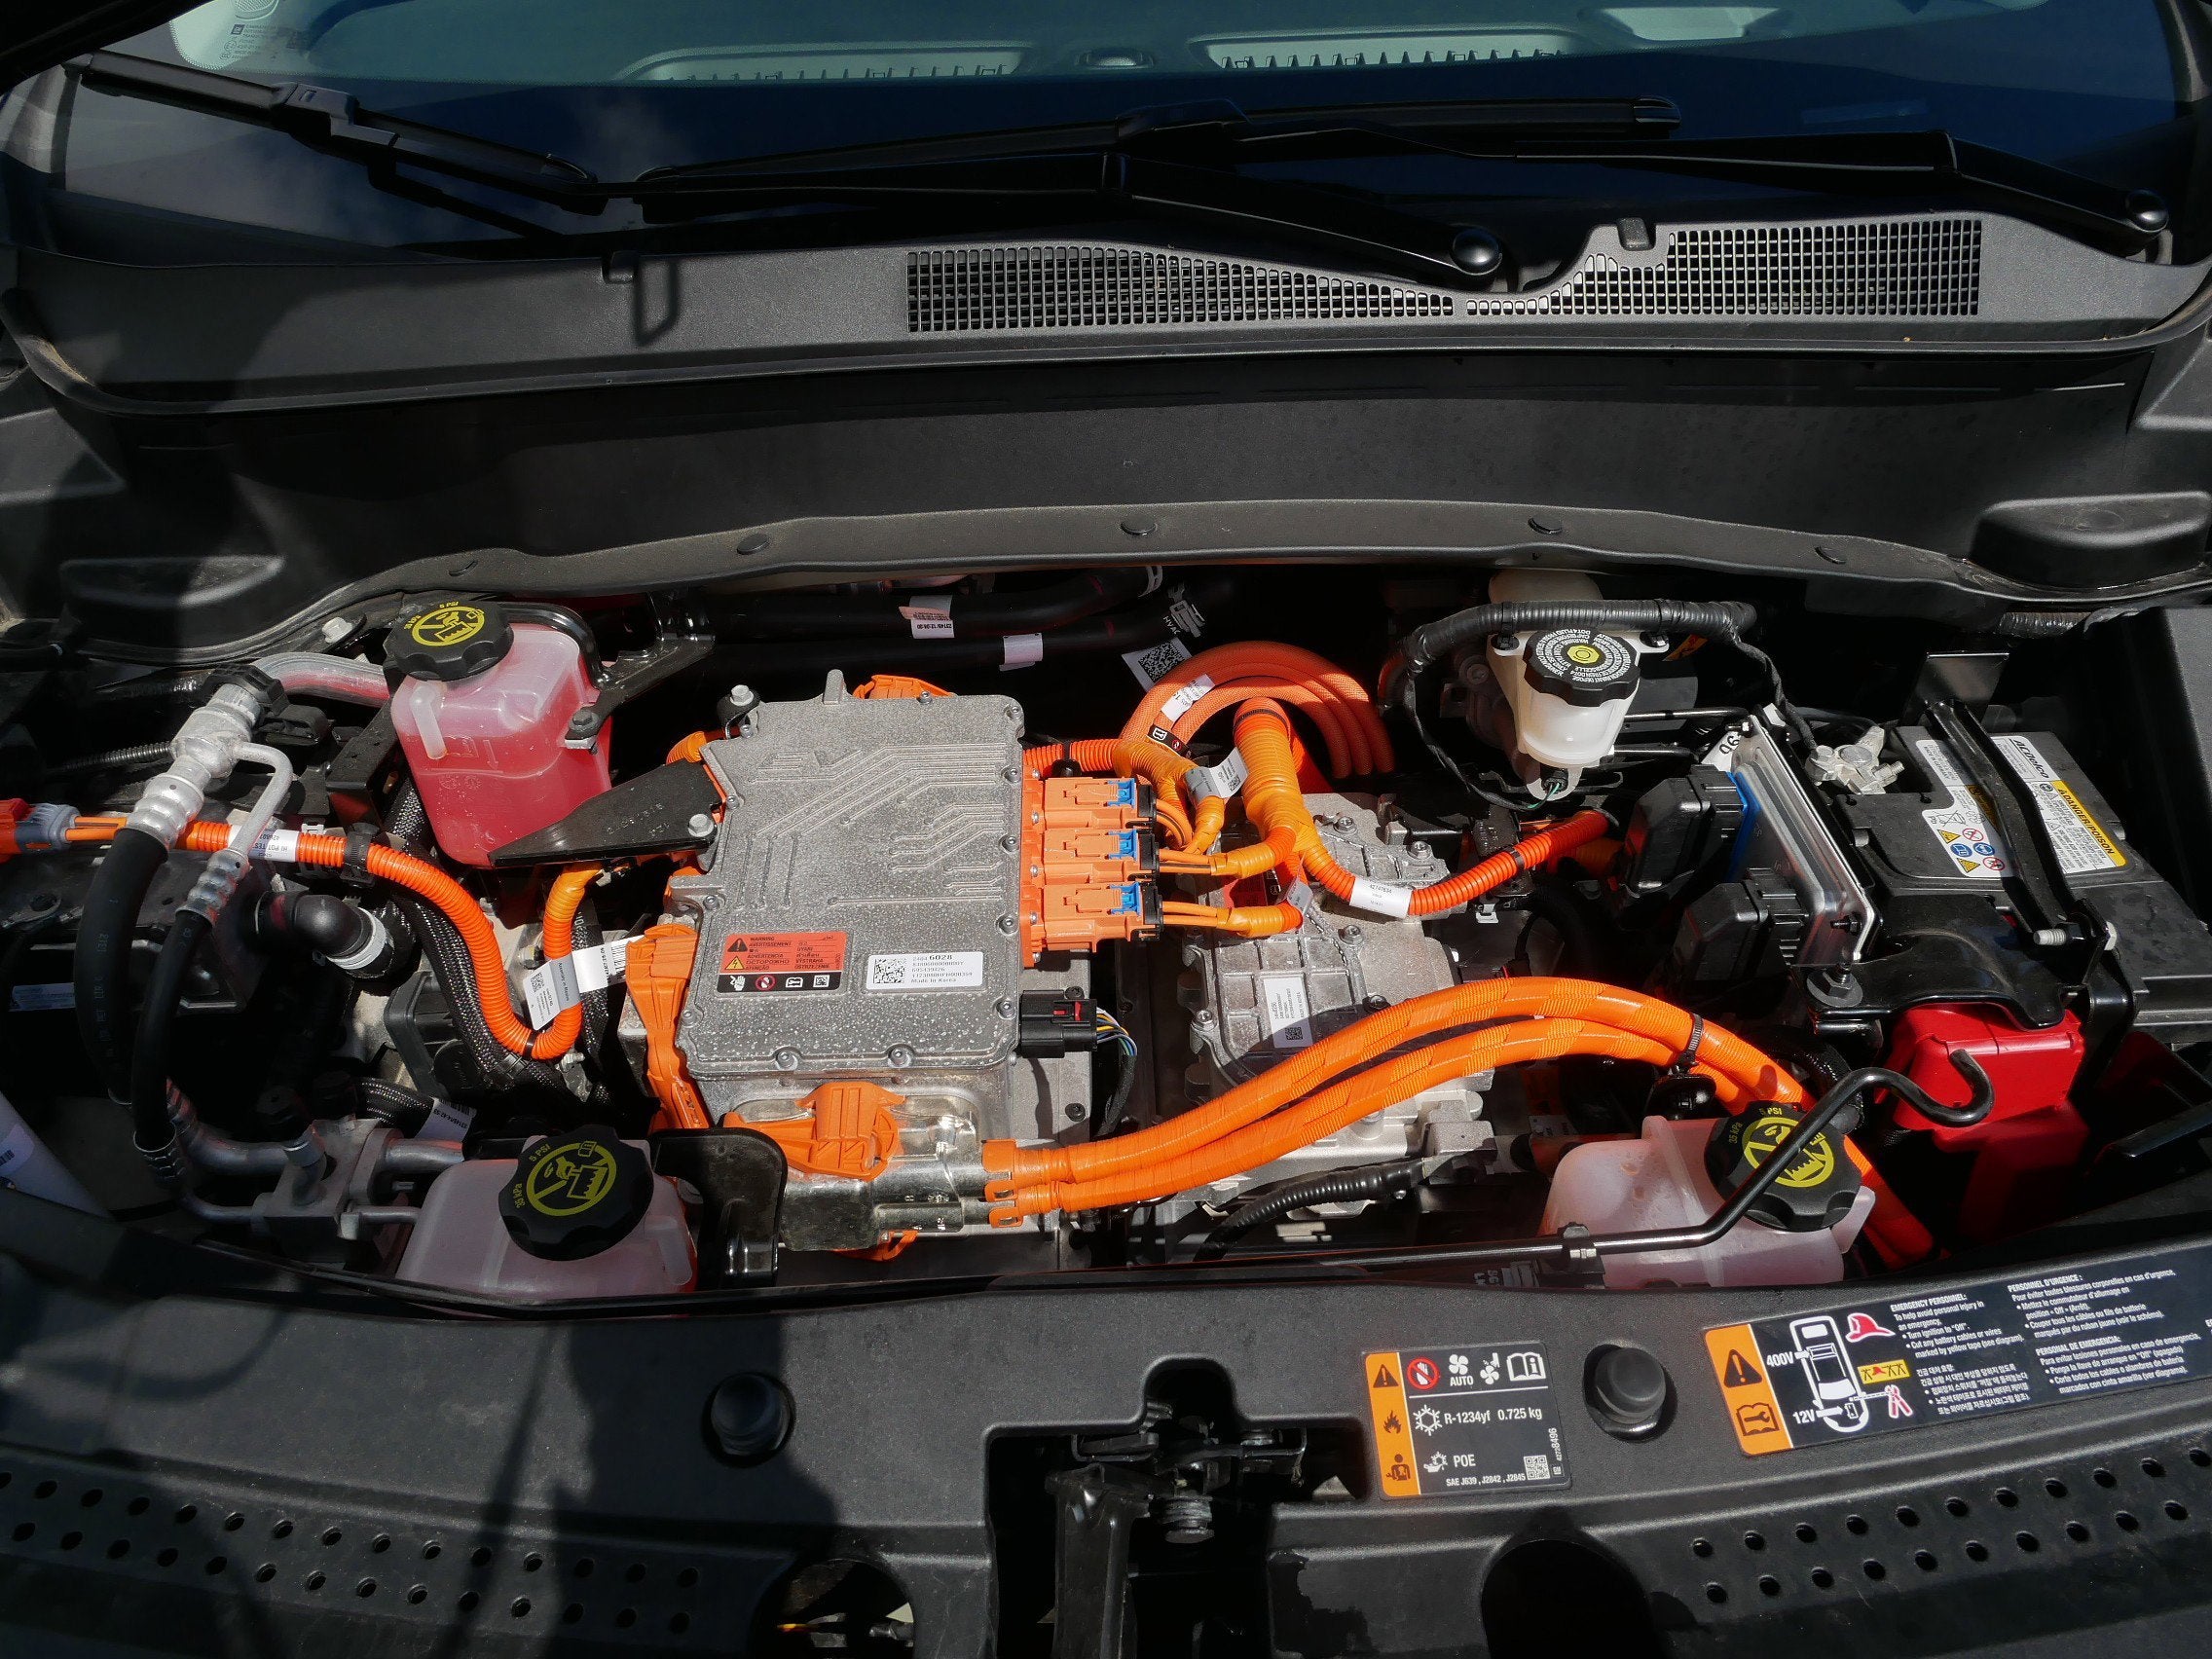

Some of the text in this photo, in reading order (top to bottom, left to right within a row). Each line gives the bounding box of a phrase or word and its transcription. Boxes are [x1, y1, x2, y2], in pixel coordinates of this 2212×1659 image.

[2064, 791, 2115, 855] DANGER/POISON
[536, 1144, 552, 1158] PSI
[513, 1183, 524, 1200] kPa
[2008, 1274, 2079, 1292] PERSONNEL D'URGENCE
[2063, 1283, 2092, 1293] blessures
[2092, 1278, 2124, 1288] corporelles
[1891, 1294, 1967, 1311] EMERGENCY PERSONNEL:
[2049, 1294, 2087, 1305] commutateur
[1917, 1309, 1934, 1317] avoid
[1934, 1305, 1960, 1315] personal
[2026, 1310, 2049, 1320] position
[2030, 1320, 2051, 1329] Couper
[2122, 1304, 2146, 1312] batterie
[2098, 1319, 2116, 1328] jaune
[1922, 1328, 1944, 1338] ignition
[1915, 1348, 1938, 1358] marked
[1947, 1345, 1967, 1354] yellow
[2036, 1345, 2070, 1356] PERSONAL
[2079, 1336, 2120, 1348] EMERGENCIA:
[2073, 1350, 2098, 1359] lesiones
[2098, 1346, 2131, 1357] personales
[1766, 1351, 1795, 1367] 400V
[2101, 1356, 2128, 1365] arranque
[2153, 1346, 2183, 1357] (apagado)
[2125, 1362, 2154, 1372] alambres
[1450, 1375, 1474, 1386] AUTO
[2059, 1383, 2089, 1393] marcados
[2118, 1374, 2143, 1383] amarilla
[2142, 1372, 2155, 1381] (ver
[1444, 1407, 1543, 1424] R-1234yf 0.725 kg
[1792, 1408, 1816, 1424] 12V
[1454, 1455, 1476, 1468] POE
[1446, 1478, 1459, 1487] SAE
